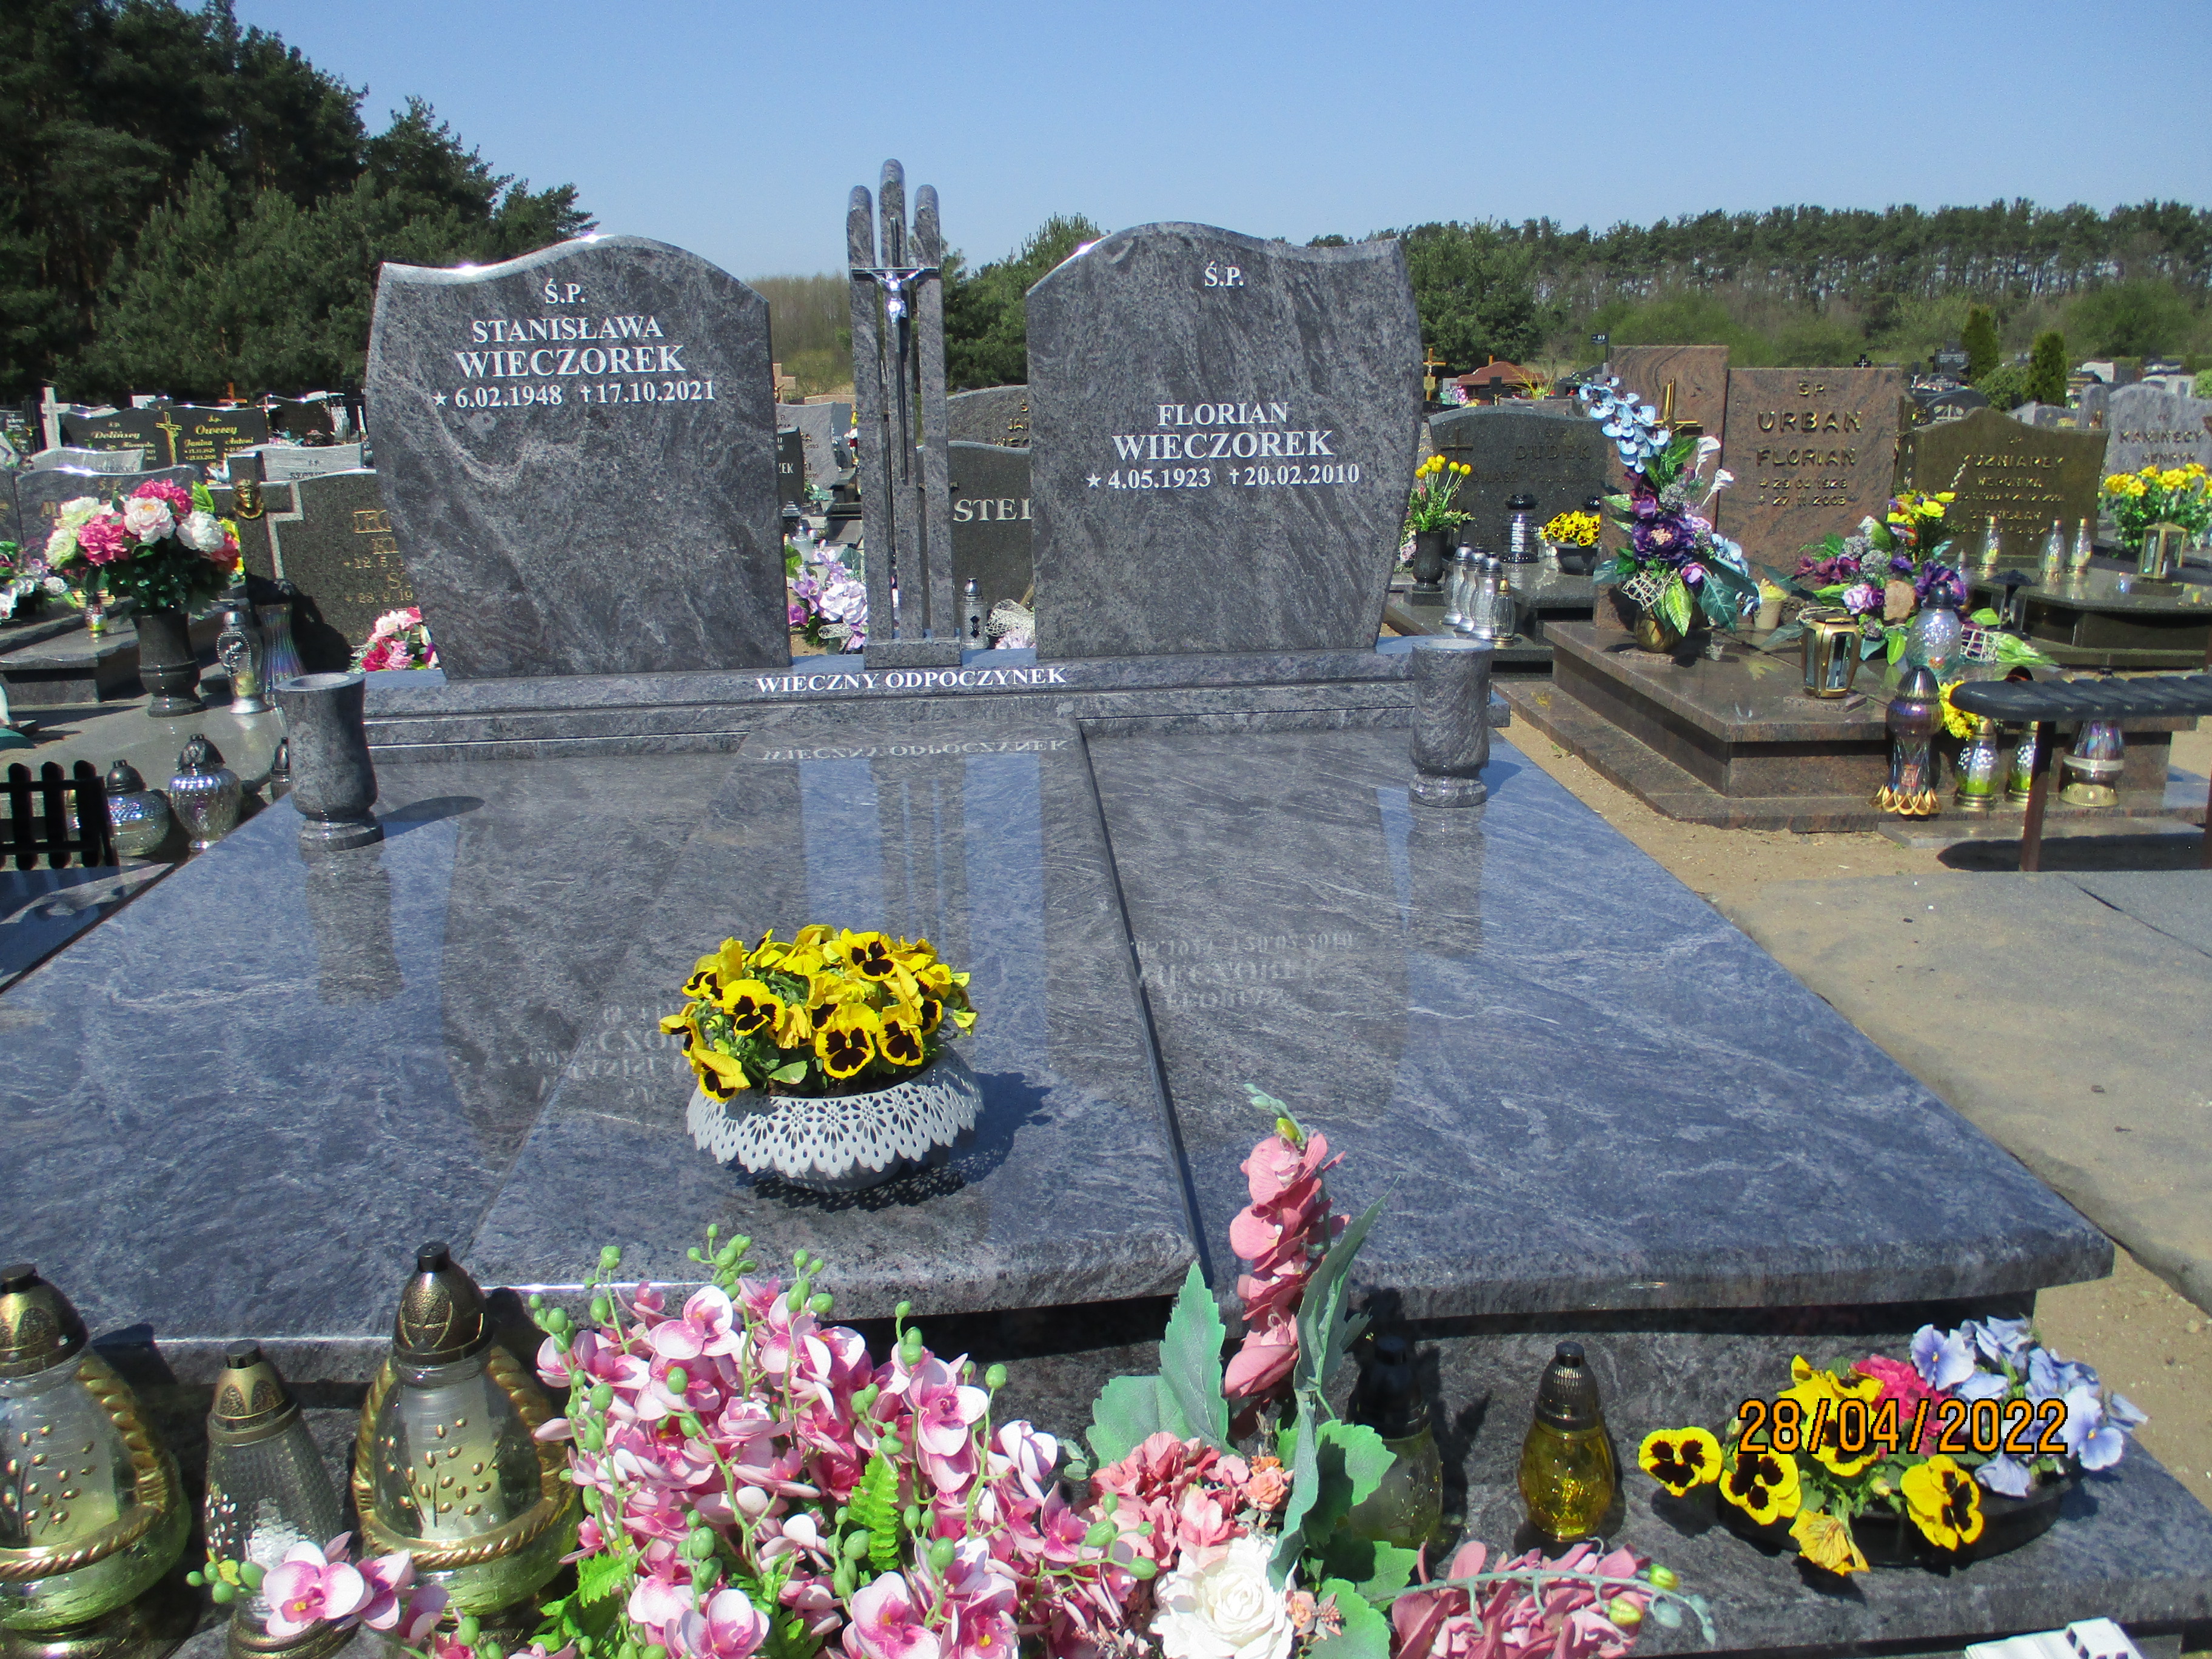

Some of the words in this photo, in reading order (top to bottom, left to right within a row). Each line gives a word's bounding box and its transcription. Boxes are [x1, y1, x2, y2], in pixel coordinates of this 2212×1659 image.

[1204, 261, 1244, 287] Ś.P.
[544, 277, 586, 305] Ś.P.
[472, 315, 664, 344] STANISŁAWA
[454, 344, 686, 379] WIECZOREK
[454, 384, 563, 409] 6.02.1948
[597, 380, 715, 404] 17.10.2021
[1157, 402, 1289, 427] FLORIAN
[1758, 411, 1862, 433] URBAN
[1111, 429, 1336, 462] WIECZOREK
[1516, 445, 1591, 460] DUDEK
[1757, 448, 1856, 466] FLORIAN
[1107, 467, 1211, 491] 4.05.1923
[1244, 463, 1359, 487] 20.02.2010
[756, 672, 879, 694] WIECZNY
[885, 667, 1068, 689] ODPOCZYNEK
